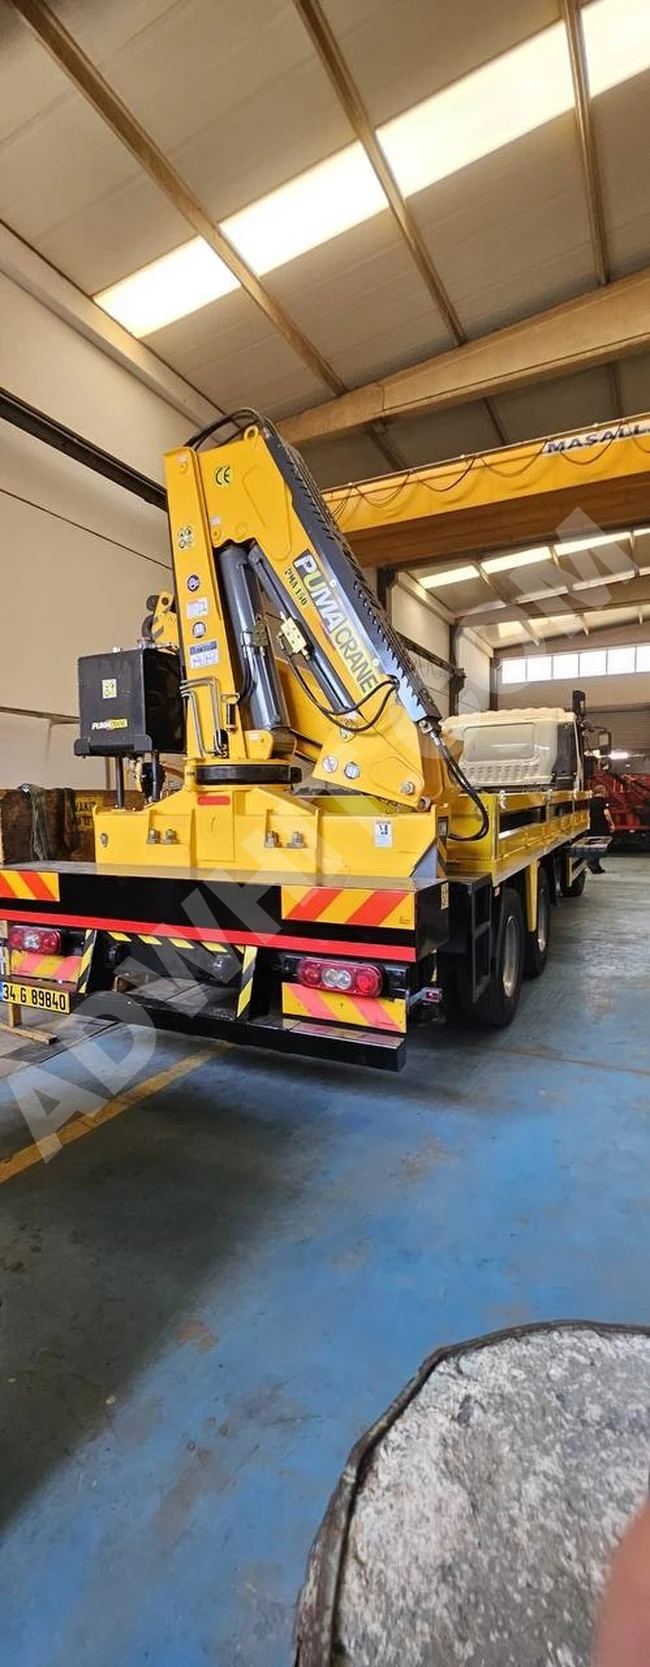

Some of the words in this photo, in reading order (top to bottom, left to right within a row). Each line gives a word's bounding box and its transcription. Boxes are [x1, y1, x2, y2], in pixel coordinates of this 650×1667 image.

[546, 424, 650, 453] MASALL
[215, 466, 230, 485] CE
[3, 984, 16, 1001] 34
[31, 989, 66, 1011] 89840
